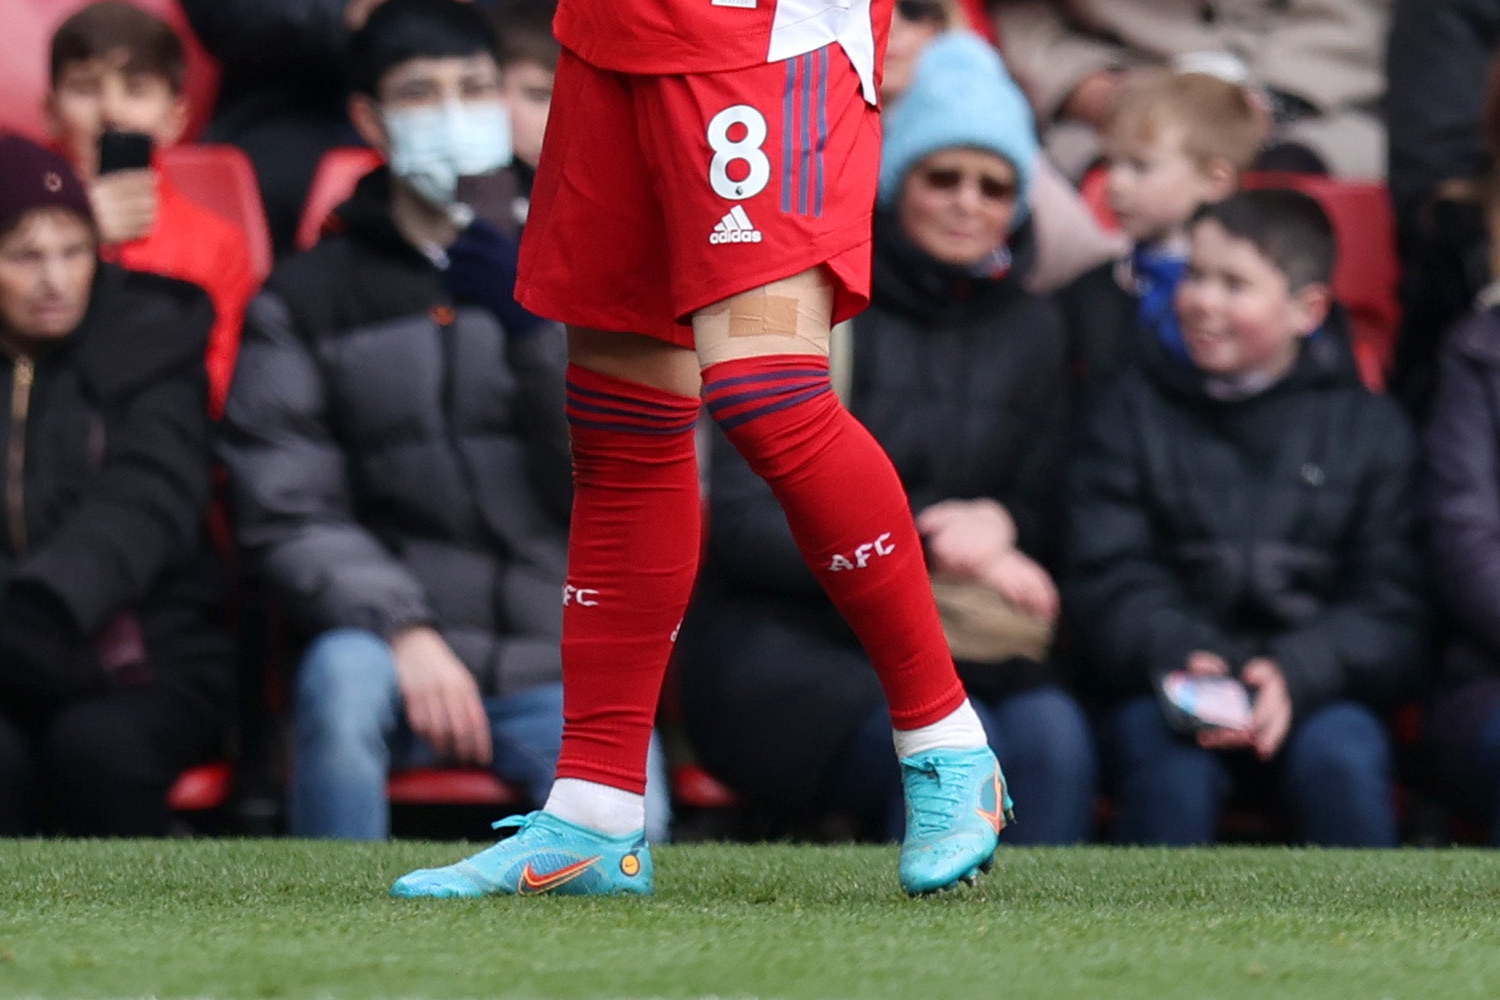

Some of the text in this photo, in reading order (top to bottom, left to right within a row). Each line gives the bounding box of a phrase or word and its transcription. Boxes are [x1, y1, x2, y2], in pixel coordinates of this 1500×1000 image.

[706, 104, 772, 201] 8
[709, 228, 762, 245] adidas
[828, 532, 896, 572] AFC
[562, 585, 600, 608] FC
